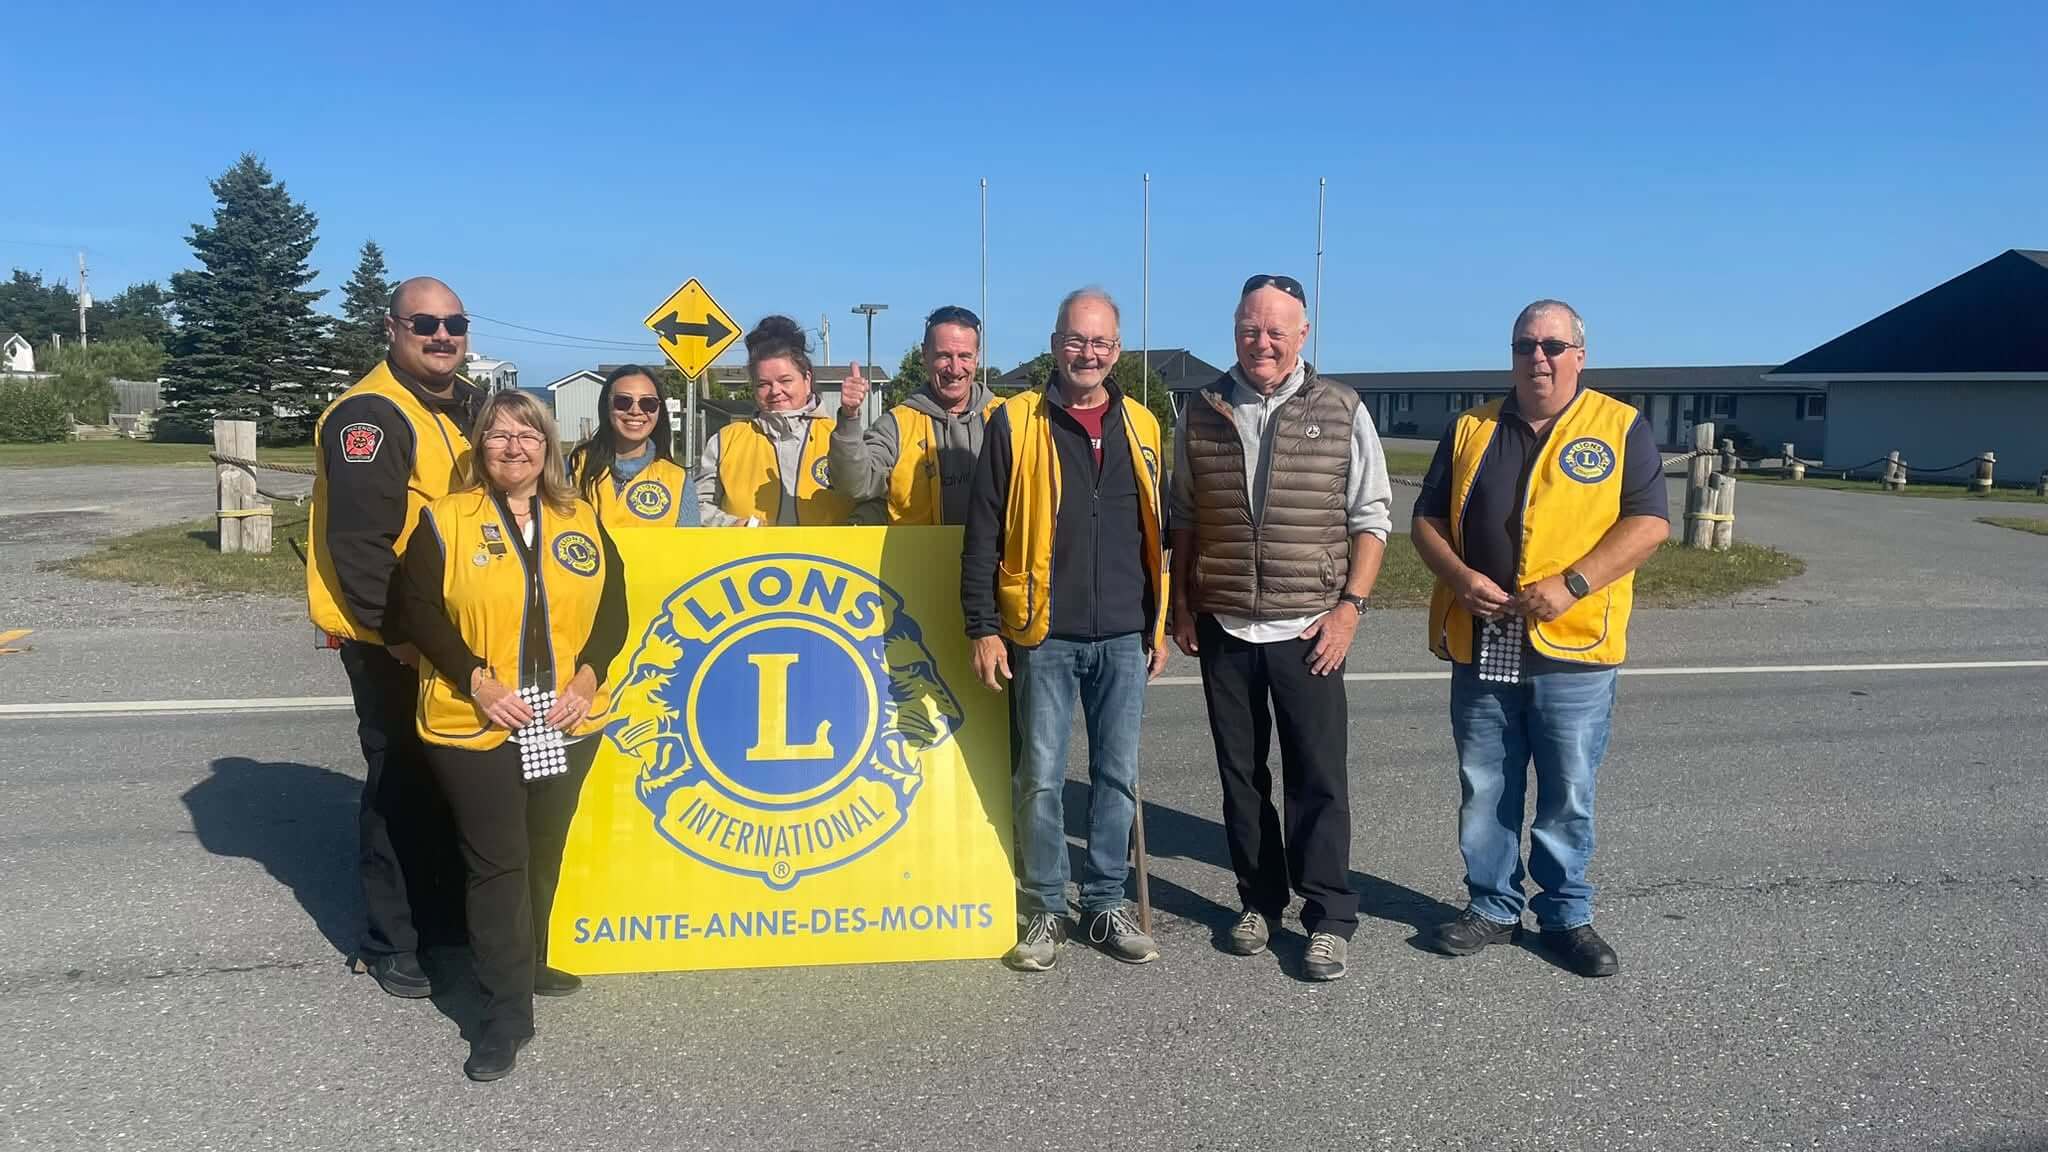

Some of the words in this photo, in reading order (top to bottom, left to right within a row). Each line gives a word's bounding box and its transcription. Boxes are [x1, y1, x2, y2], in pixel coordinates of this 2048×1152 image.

[1575, 442, 1602, 450] LIONS
[1583, 452, 1595, 466] L
[644, 492, 655, 504] L
[571, 546, 586, 559] L
[682, 566, 887, 634] LIONS
[745, 652, 834, 761] L
[677, 794, 886, 858] INTERNATIONAL
[573, 903, 994, 944] SAINTE-ANNE-DES-MONTS
